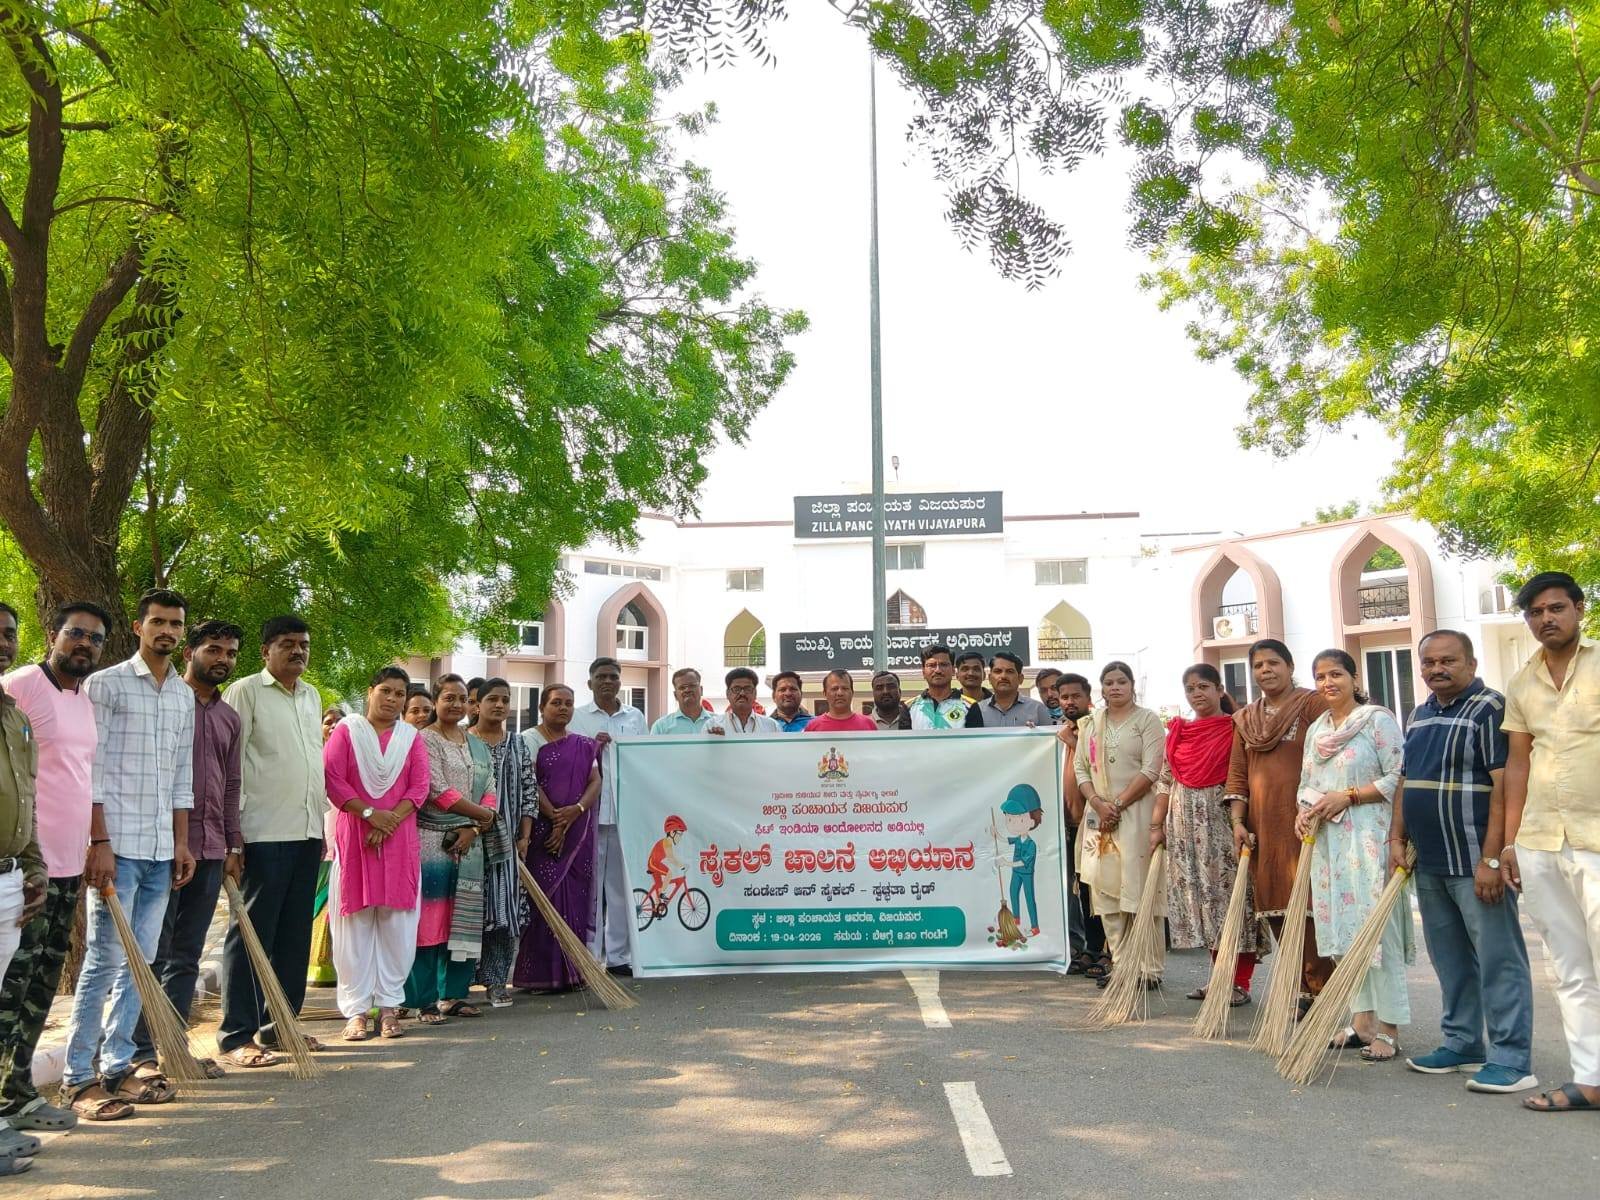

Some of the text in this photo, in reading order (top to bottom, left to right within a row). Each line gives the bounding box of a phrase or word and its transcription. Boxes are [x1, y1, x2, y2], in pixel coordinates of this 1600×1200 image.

[918, 497, 986, 511] ವಿಜಯಪುರ
[812, 518, 986, 533] ZILLA PANCAYATH VIJAYAPURA
[795, 637, 834, 660] ಮುಖ್ಯ
[946, 631, 1012, 650] ಅಧಿಕಾರಿಗಳ
[762, 801, 908, 820] ಜಿಲ್ಲಾ ಪಂಚಾಯತ ವಿಜಯಪುರ
[755, 820, 925, 836] ಫಿಟ್ ಇಂಡಿಯಾ ಆಂದೋಲನದ ಅಡಿಯಲ್ಲಿ
[699, 840, 976, 887] ಸೈಕಲ್ ಚಾಲನೆ ಅಭಿಯಾನ
[744, 884, 788, 896] ಸಂಡೇಸ್
[793, 884, 816, 896] ಆನ್
[820, 883, 855, 902] ಸೈಕಲ್
[910, 881, 936, 901] ರೈಡ್
[752, 913, 766, 929] ಸ್ಥಳ
[776, 914, 795, 927] ಜಿಲ್ಲಾ
[798, 913, 841, 923] ಪಂಚಾಯತ
[729, 931, 761, 942] ದಿನಾಂಕ
[771, 933, 822, 942] 19-04-2026
[834, 930, 862, 941] ಸಮಯ
[920, 929, 948, 940] ಗಂಟೆಗೆ
